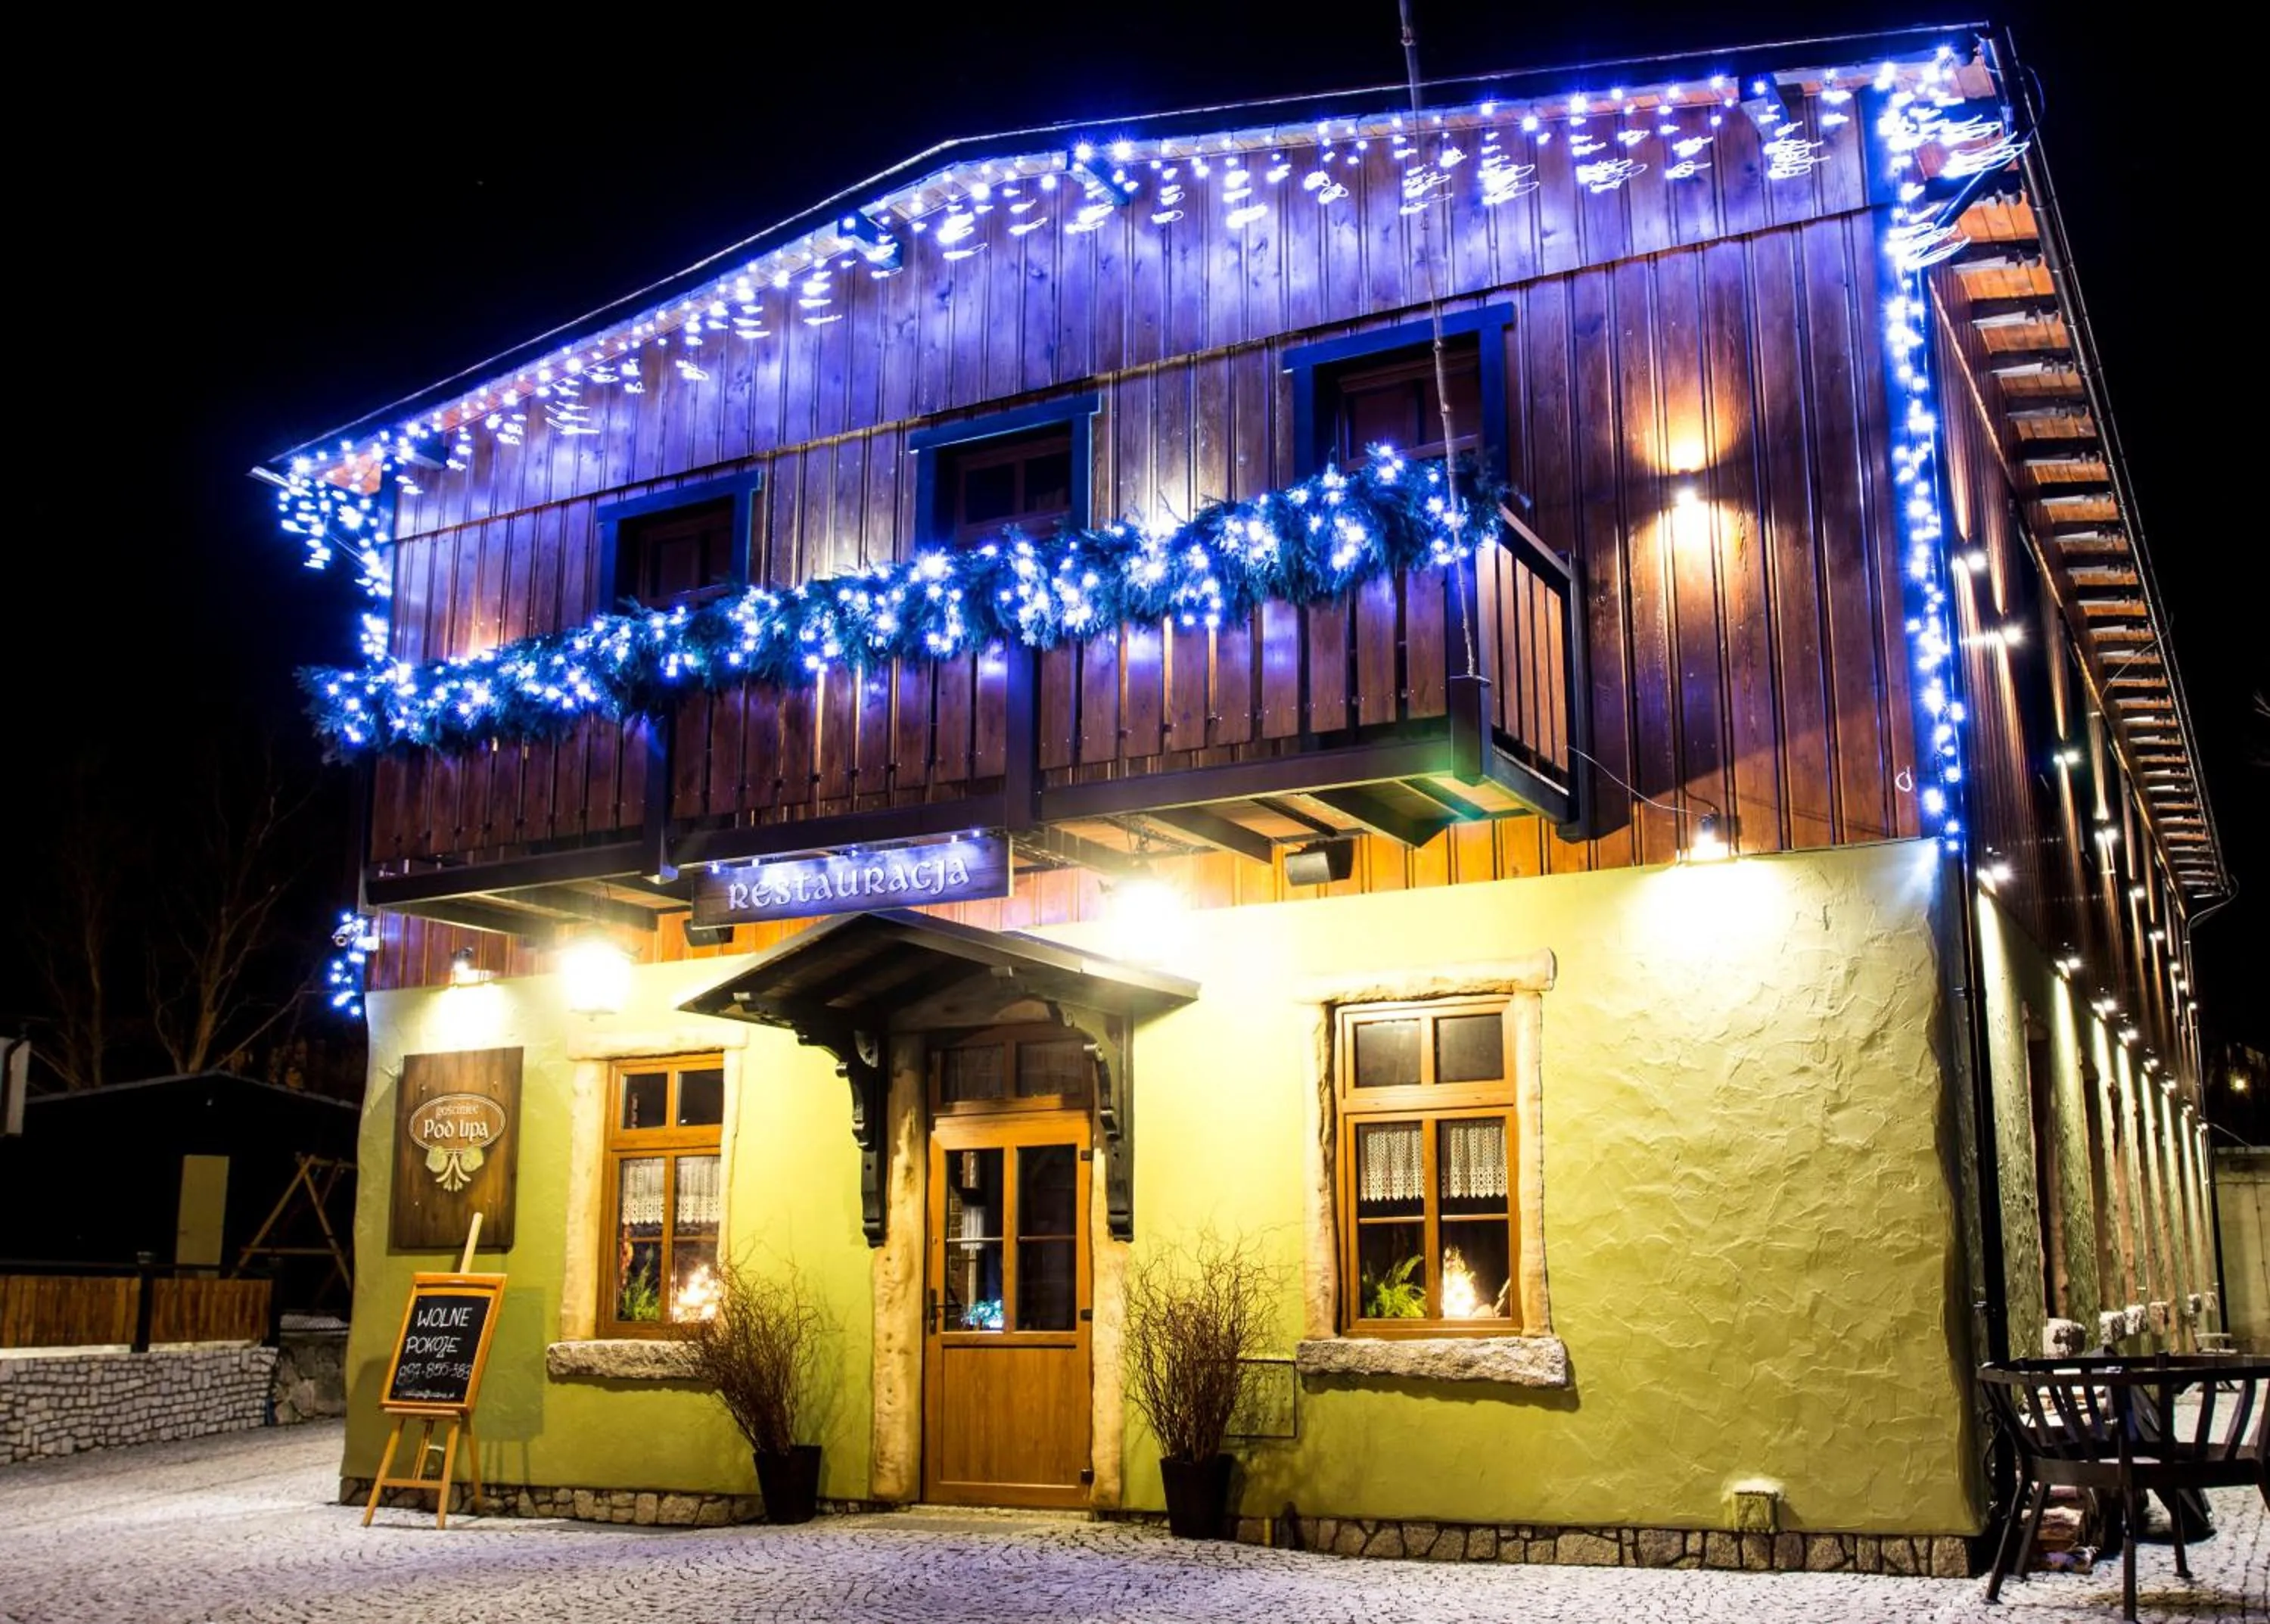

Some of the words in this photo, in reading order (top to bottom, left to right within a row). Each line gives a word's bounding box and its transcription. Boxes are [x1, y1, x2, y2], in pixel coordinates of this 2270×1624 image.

[423, 1118, 455, 1139] Pod
[418, 1307, 473, 1327] WOLNE
[405, 1336, 461, 1358] POKOJE
